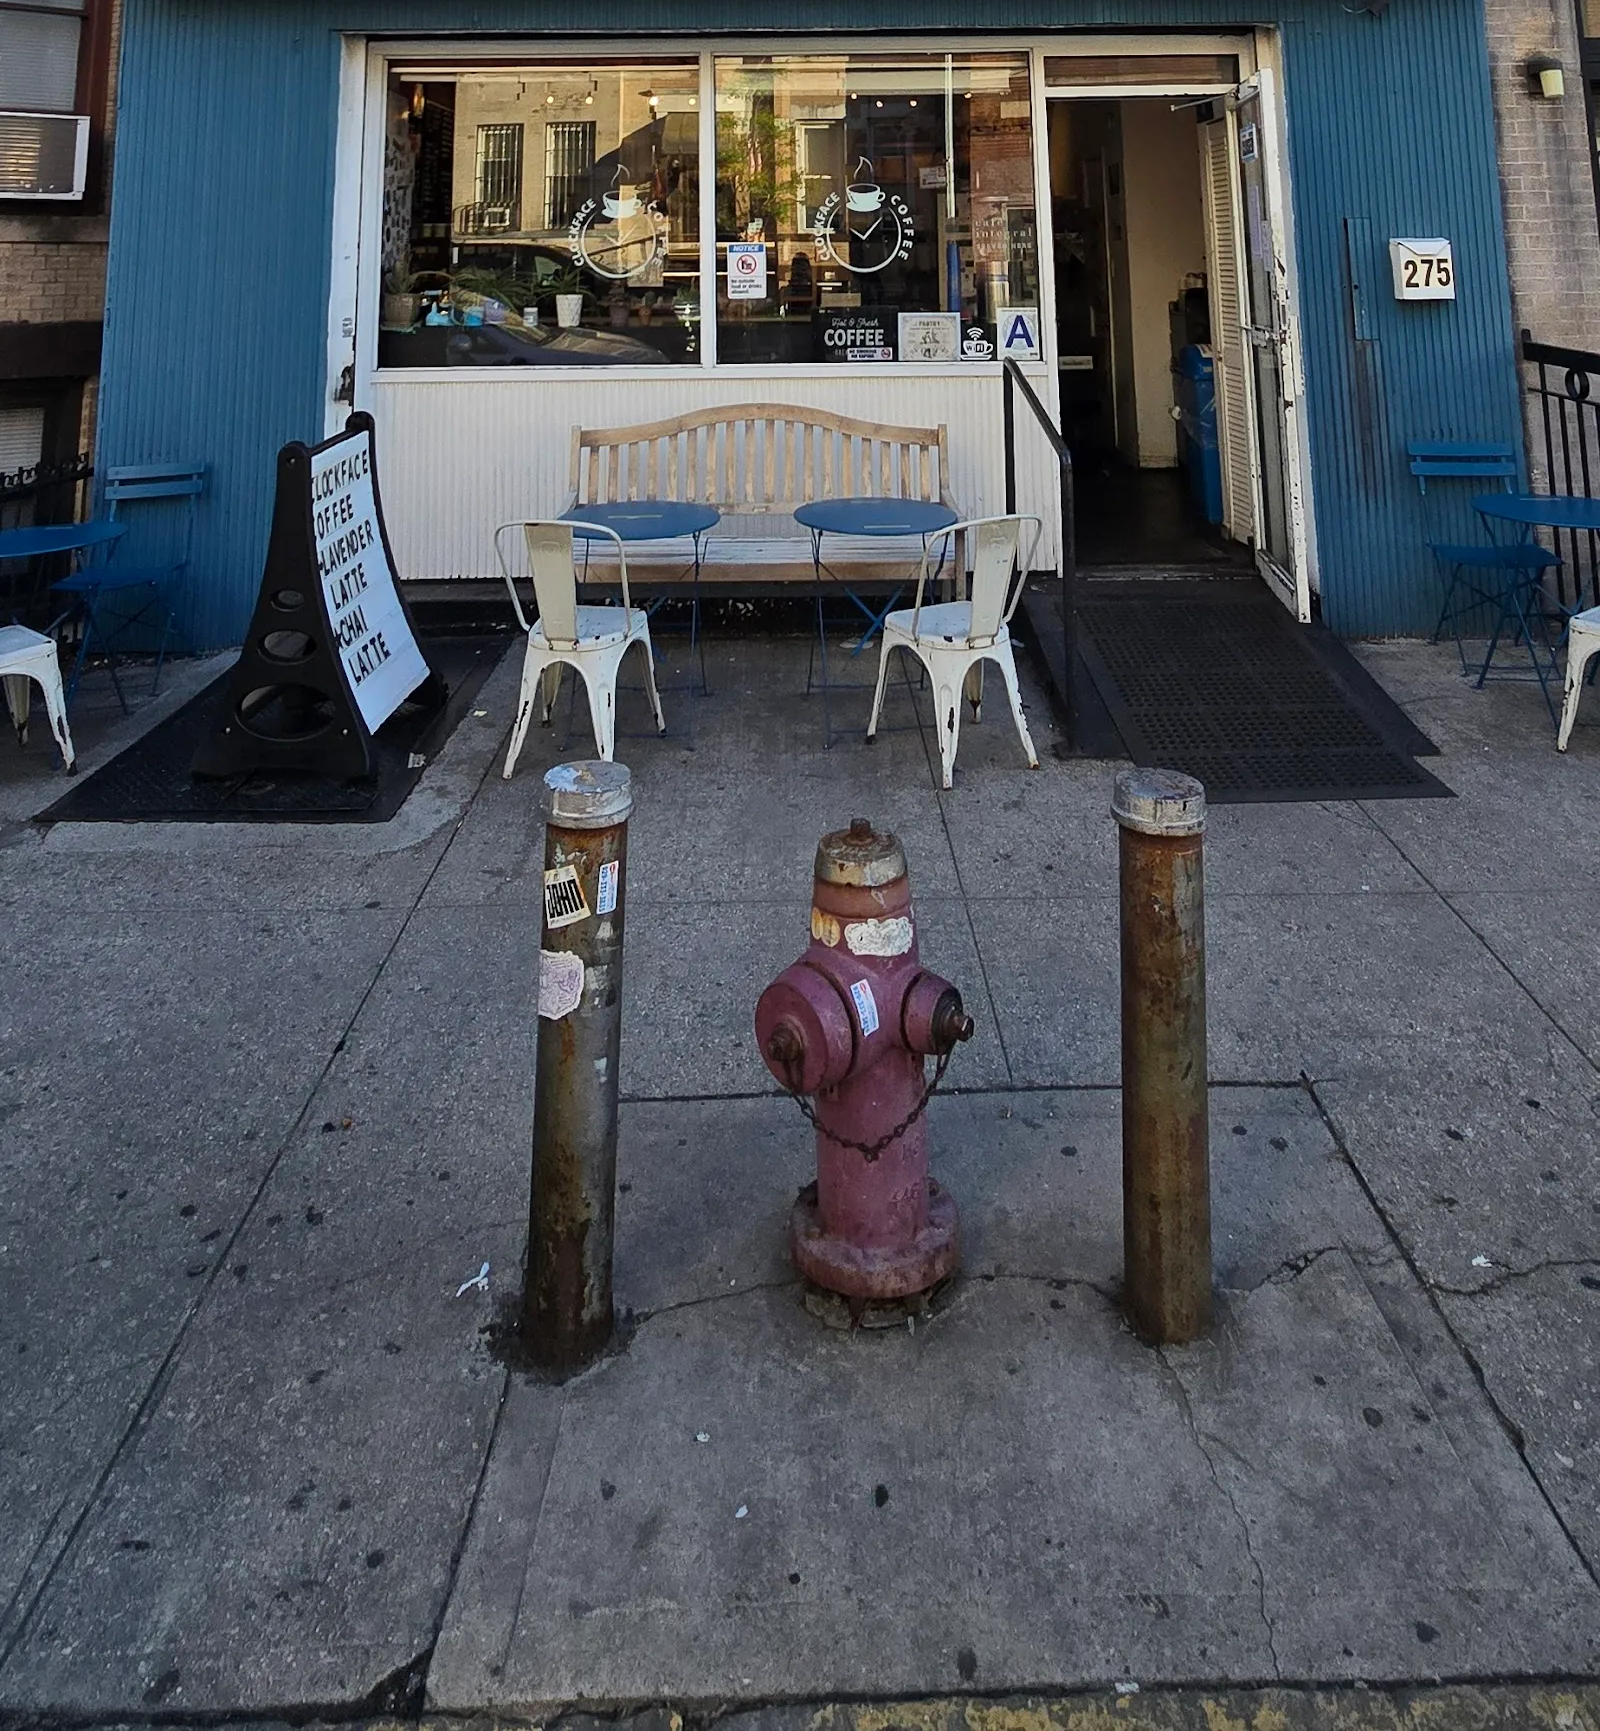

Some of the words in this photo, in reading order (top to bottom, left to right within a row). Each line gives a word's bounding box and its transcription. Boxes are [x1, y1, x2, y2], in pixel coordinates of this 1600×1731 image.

[568, 198, 597, 267] CLOCKFACE
[647, 200, 671, 267] COFFEE
[813, 191, 840, 262] CLOCKFACE
[890, 195, 915, 261] COFFEE
[1404, 259, 1451, 288] 275
[824, 329, 884, 346] COFFEE
[856, 318, 879, 328] Fresh
[1005, 315, 1034, 348] A
[316, 494, 354, 540] OFFEE
[330, 562, 368, 610] LATTE
[348, 632, 392, 683] LATTE
